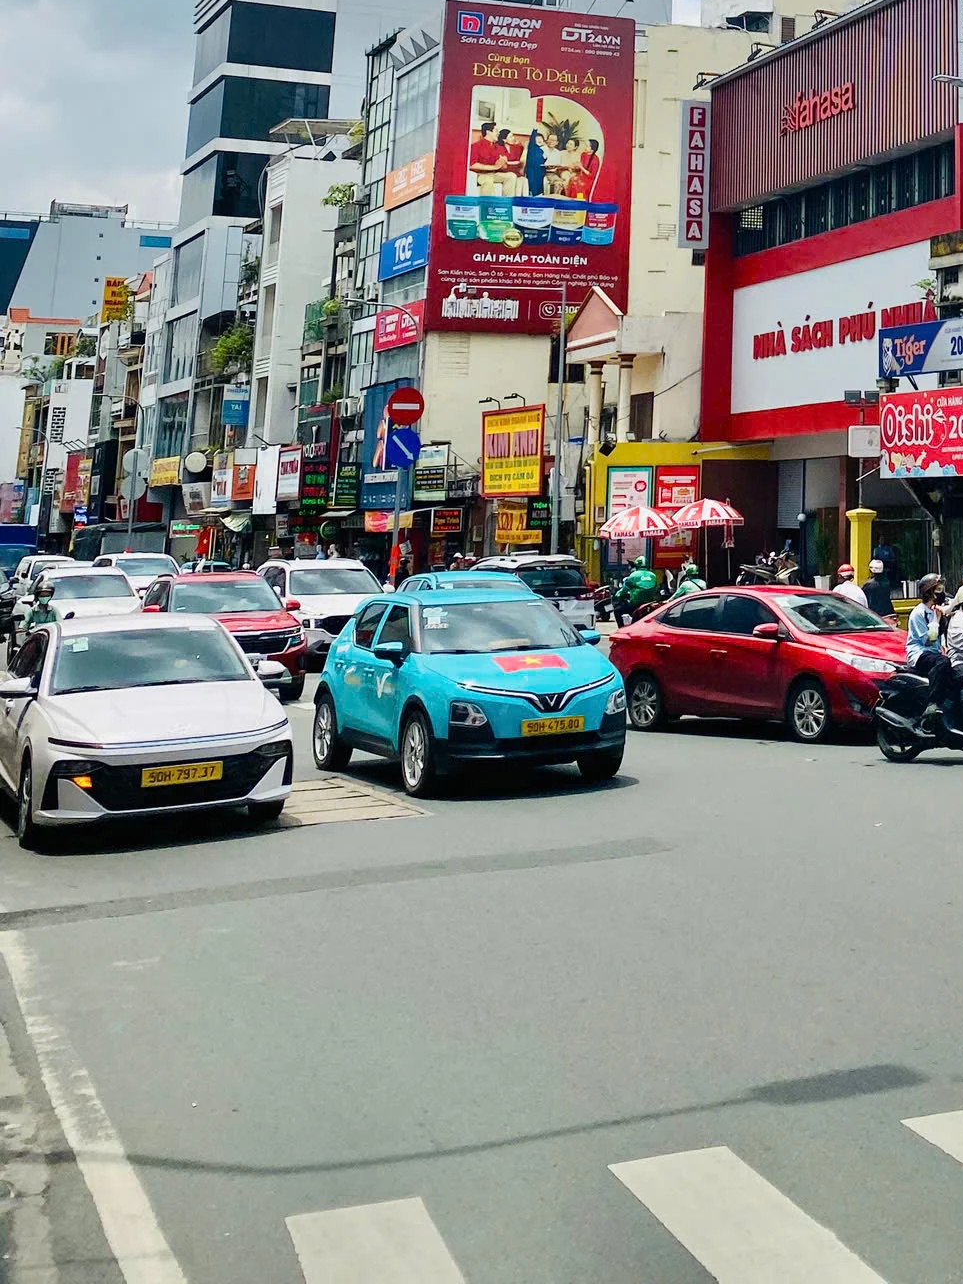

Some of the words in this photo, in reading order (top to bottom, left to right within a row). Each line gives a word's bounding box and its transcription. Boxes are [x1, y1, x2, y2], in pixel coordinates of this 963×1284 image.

[488, 16, 542, 28] NIPPON
[491, 26, 532, 38] PAINT
[460, 36, 477, 44] Sơn
[498, 39, 519, 48] Cũng
[488, 53, 510, 64] Cùng
[513, 55, 530, 65] bạn
[522, 66, 542, 81] Tô
[546, 68, 578, 84] Dấu
[582, 68, 606, 86] Ấn
[560, 85, 579, 94] cuộc
[582, 86, 596, 95] đời
[796, 82, 854, 131] fahasa
[687, 108, 704, 239] FAHASA
[473, 252, 496, 262] GIẢI
[499, 253, 528, 262] PHÁP
[530, 254, 560, 264] TOÀN
[562, 255, 588, 267] DIỆN
[753, 321, 787, 360] NHÀ
[791, 315, 834, 353] SÁCH
[839, 302, 876, 345] PHÚ
[894, 334, 926, 365] Tiger
[882, 403, 934, 448] Oishi
[487, 432, 510, 459] KIM
[513, 429, 538, 456] ANH
